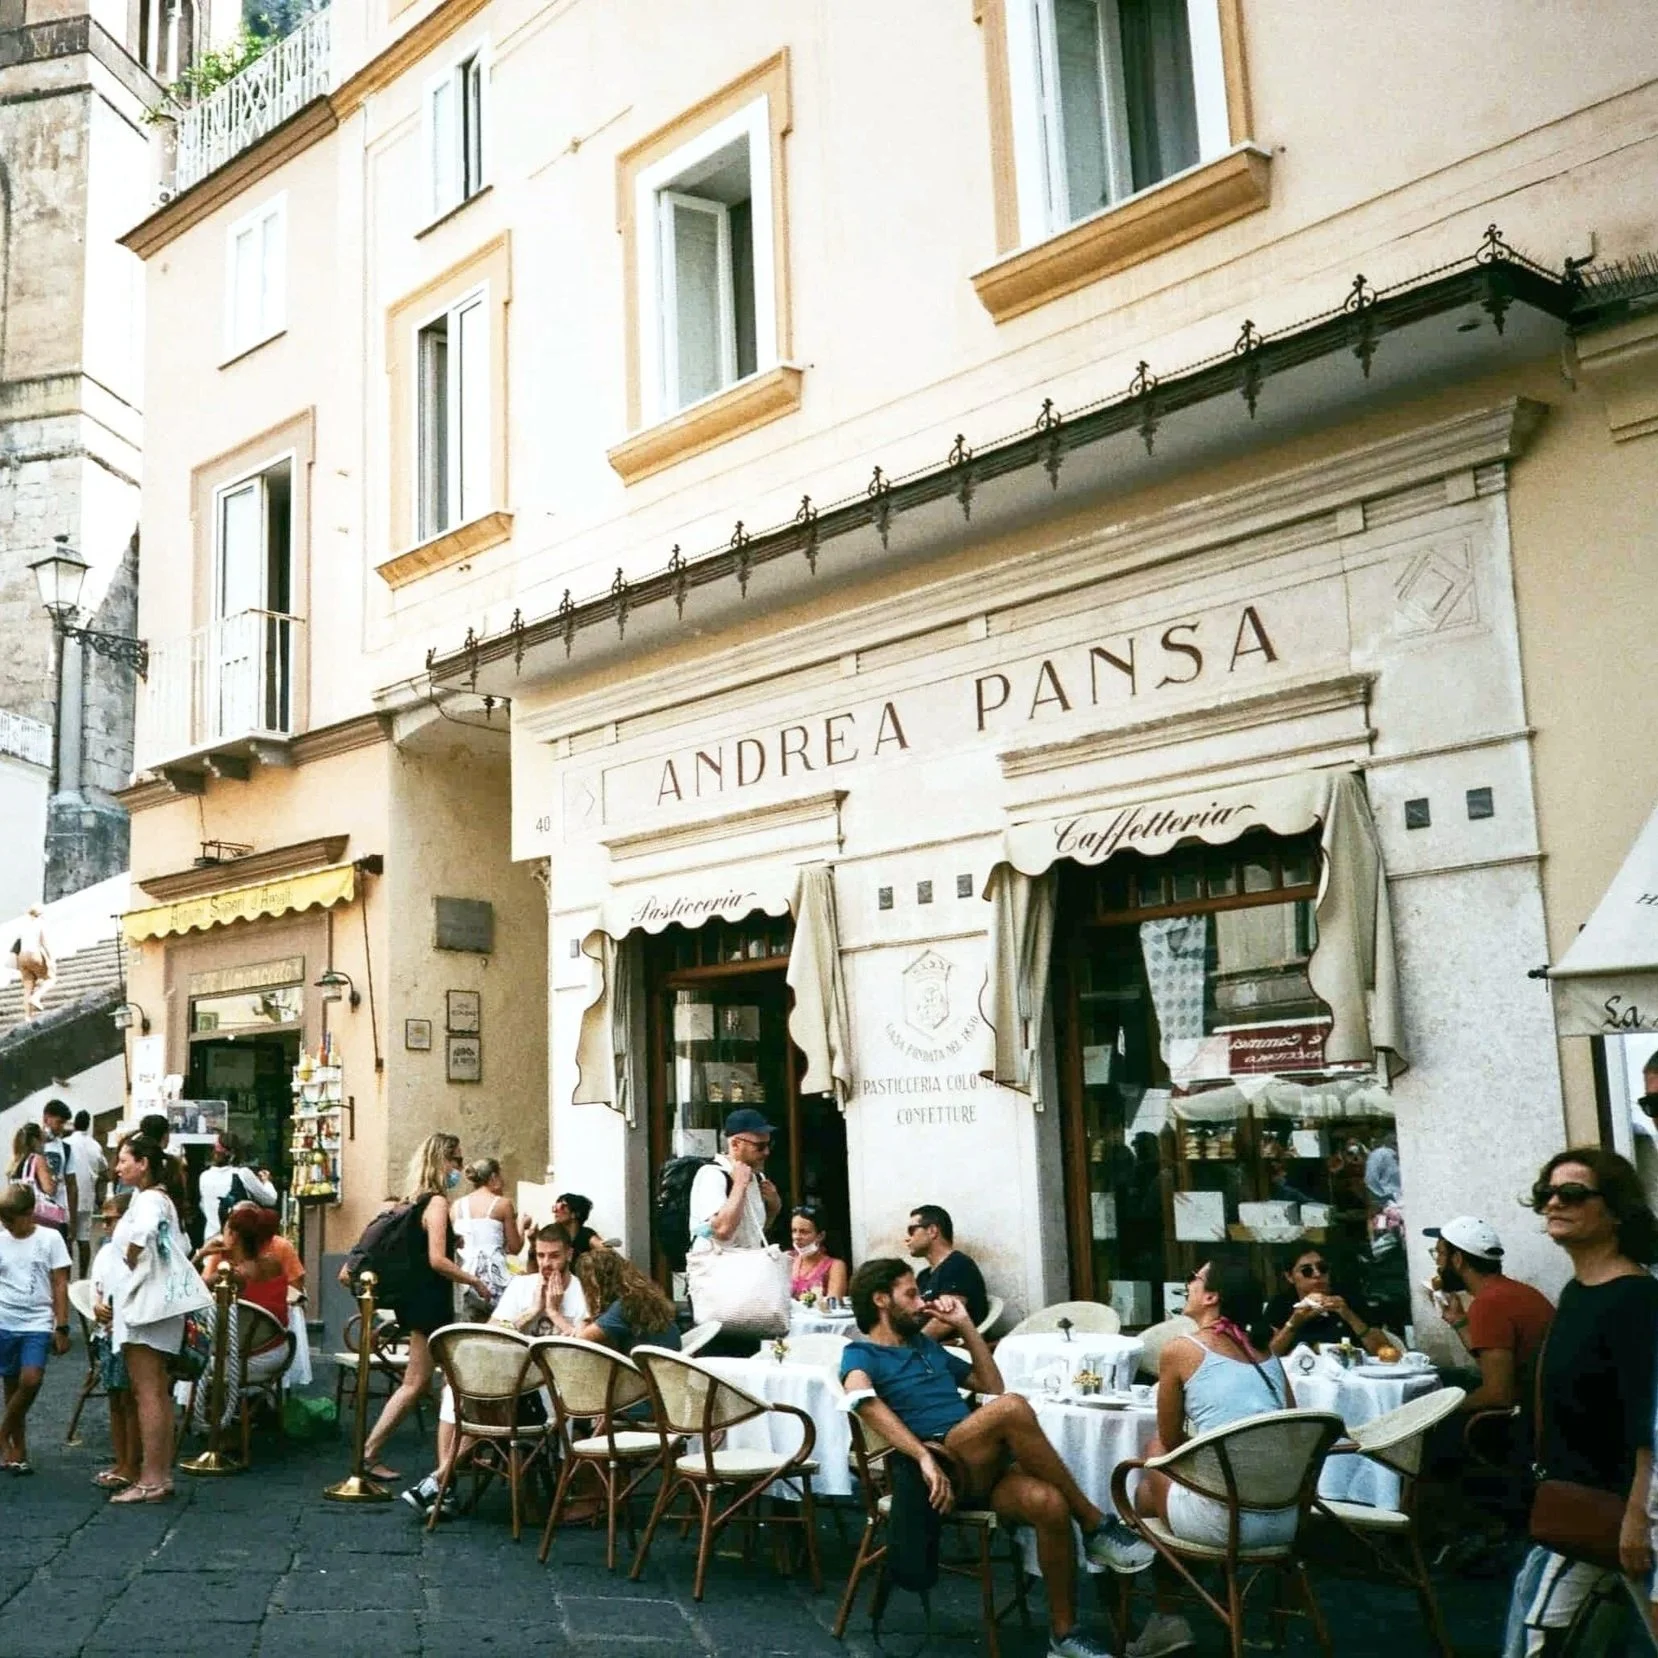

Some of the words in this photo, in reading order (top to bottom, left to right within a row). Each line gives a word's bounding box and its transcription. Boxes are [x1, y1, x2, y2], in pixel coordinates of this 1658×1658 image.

[657, 700, 911, 806] ANDREA
[974, 605, 1279, 732] PANSA
[535, 815, 551, 832] 40
[1053, 801, 1256, 857] Caffetteria
[629, 889, 757, 921] Pasticceria
[863, 1075, 941, 1096] PASTICCERIA
[896, 1105, 976, 1126] CONFETTURE
